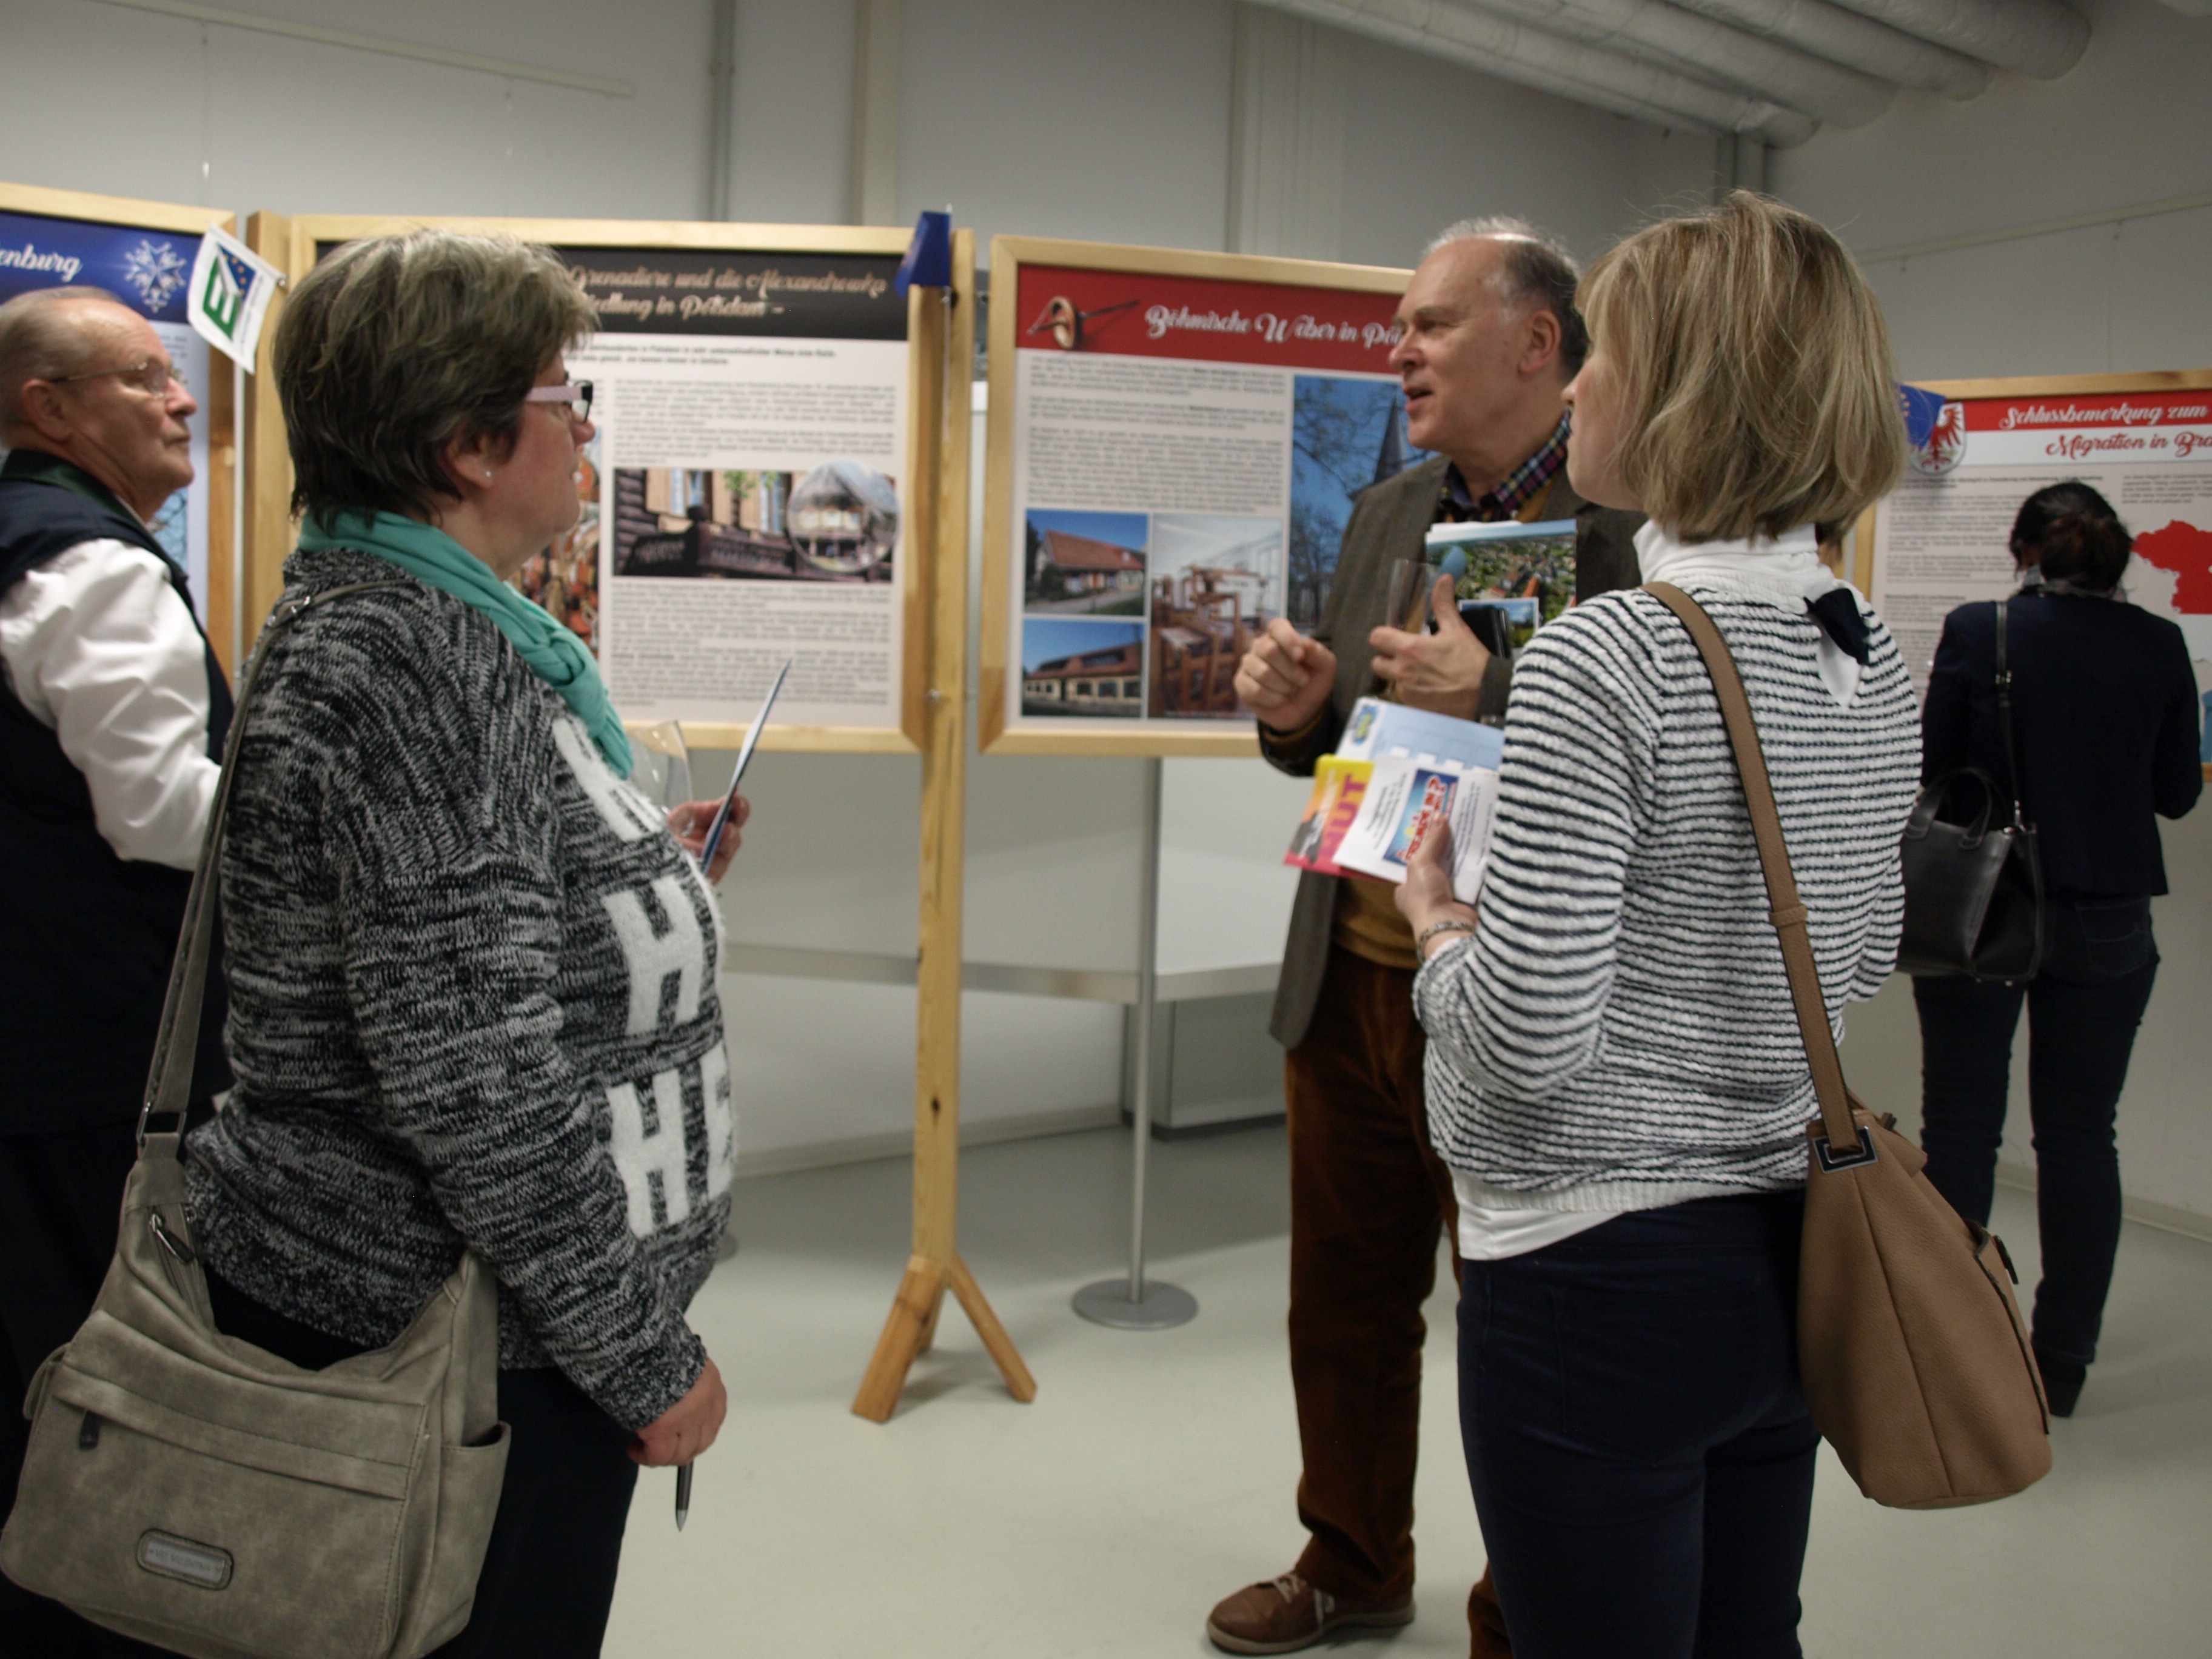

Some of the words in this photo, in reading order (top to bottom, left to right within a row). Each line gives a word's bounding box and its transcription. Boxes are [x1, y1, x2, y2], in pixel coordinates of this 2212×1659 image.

[675, 267, 715, 289] und
[714, 267, 743, 290] die
[655, 295, 676, 316] in
[679, 294, 766, 322] Potsdam
[1144, 304, 1253, 340] Böhmische
[1254, 312, 1337, 344] Weber
[1338, 320, 1359, 343] in
[1999, 401, 2163, 431] Schlussbemerkung
[2167, 404, 2209, 420] zum
[2045, 432, 2145, 460] Migration
[2149, 434, 2169, 449] in
